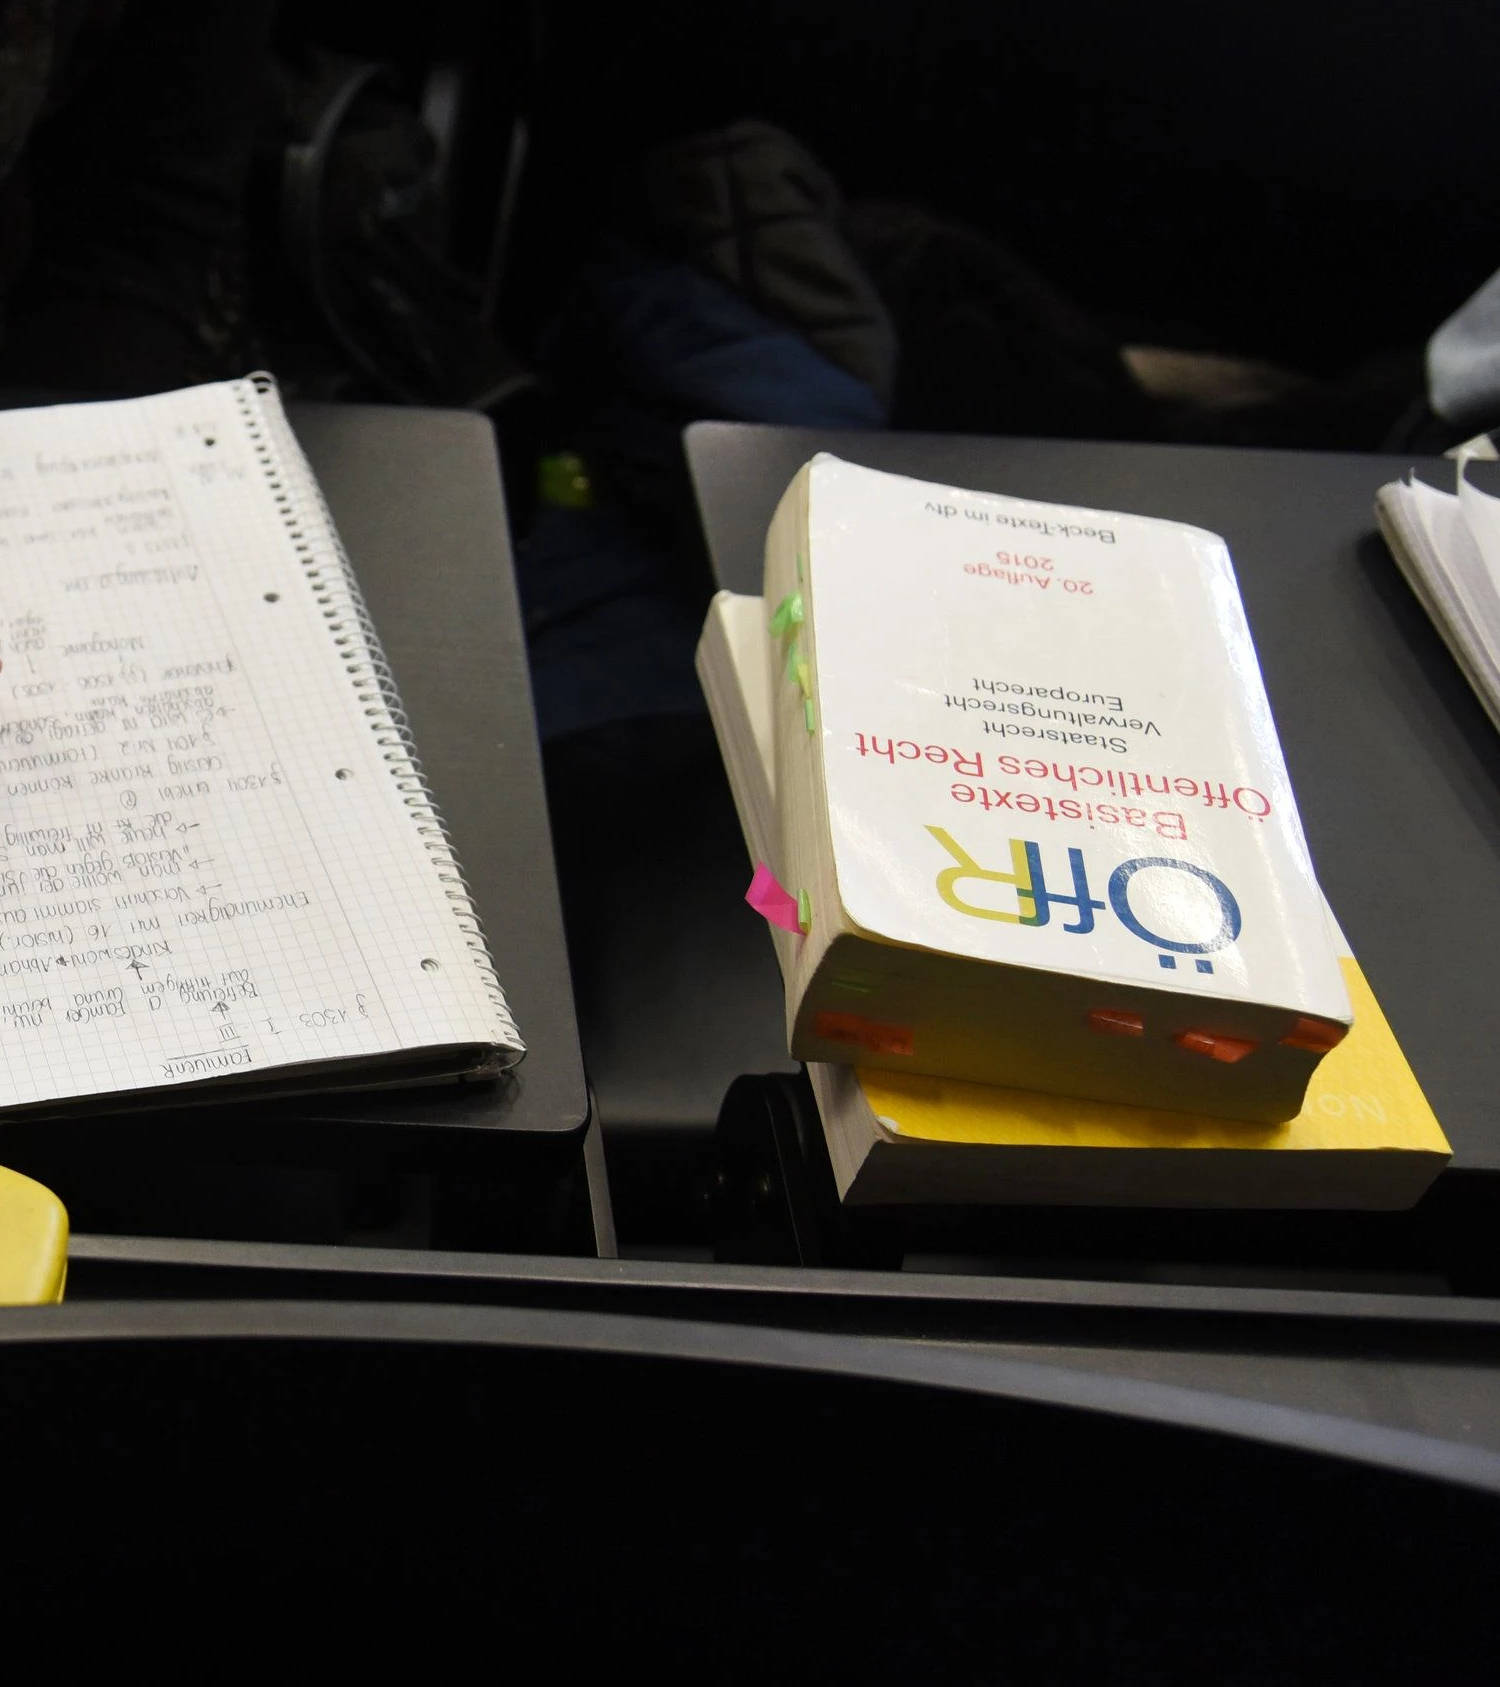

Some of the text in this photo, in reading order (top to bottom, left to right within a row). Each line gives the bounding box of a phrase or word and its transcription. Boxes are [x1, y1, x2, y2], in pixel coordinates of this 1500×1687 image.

[924, 502, 1117, 545] Beck-Texte im dtv
[962, 563, 1095, 595] 20. Auflage
[995, 550, 1055, 572] 2015
[972, 677, 1123, 712] Europarecht
[944, 693, 1162, 737] Verwaltungsrecht
[982, 720, 1127, 754] Staatsrecht
[855, 732, 1272, 824] Öffentliches Recht
[950, 782, 1189, 841] Basistexte
